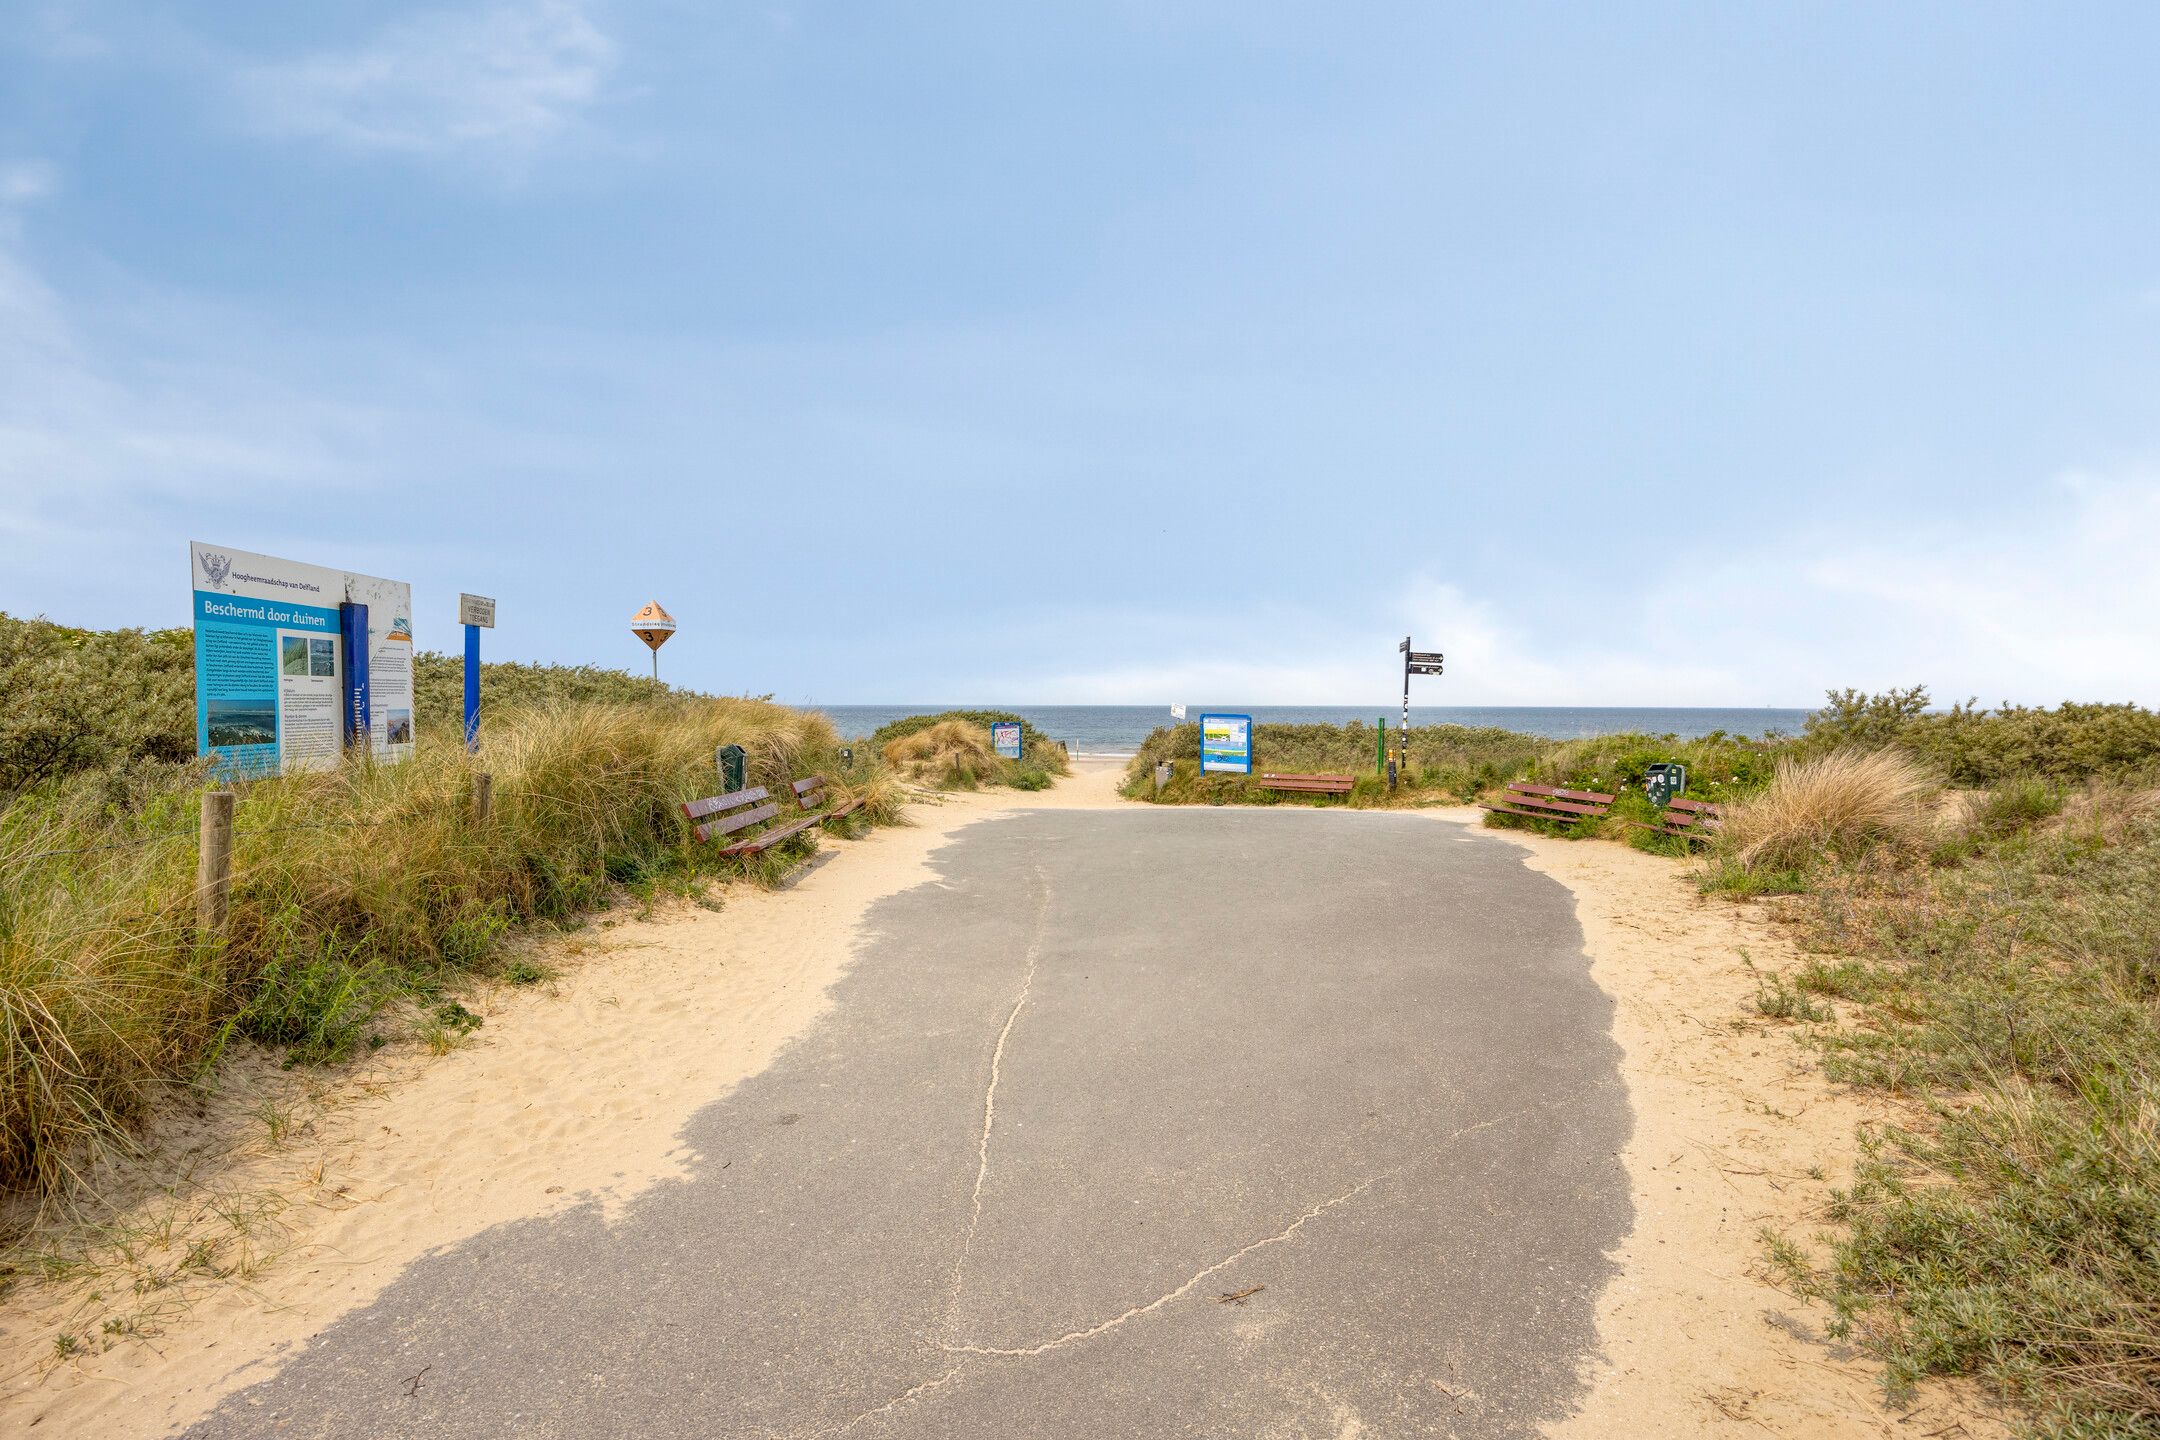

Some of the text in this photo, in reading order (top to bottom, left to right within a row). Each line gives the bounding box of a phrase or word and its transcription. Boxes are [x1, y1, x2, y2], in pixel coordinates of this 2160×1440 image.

[232, 572, 288, 589] Hoogheemraadschap
[299, 583, 320, 593] Delfland
[204, 600, 326, 626] Beschermd door duinen
[643, 606, 652, 616] 3
[644, 631, 654, 642] 3
